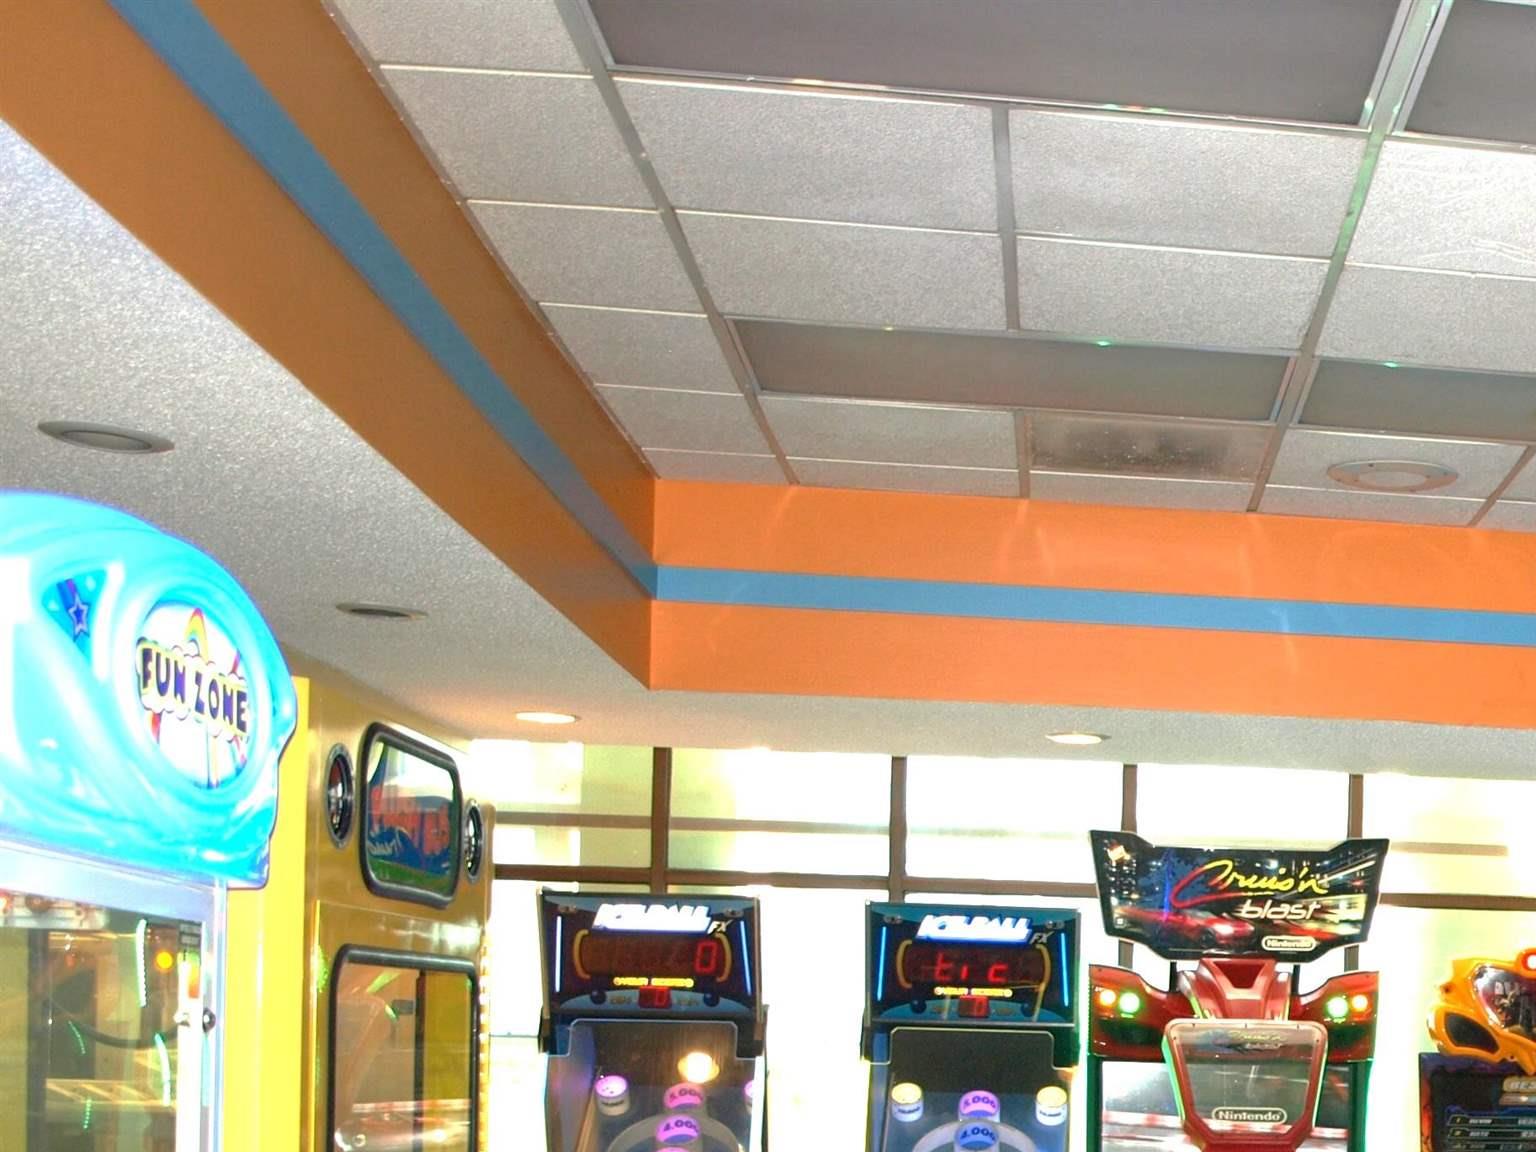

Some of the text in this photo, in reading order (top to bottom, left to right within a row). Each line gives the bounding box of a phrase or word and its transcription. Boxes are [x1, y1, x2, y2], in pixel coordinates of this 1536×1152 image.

[141, 647, 247, 734] FUN ZONE
[1240, 898, 1321, 920] blast
[1217, 1110, 1282, 1122] Nintendo
